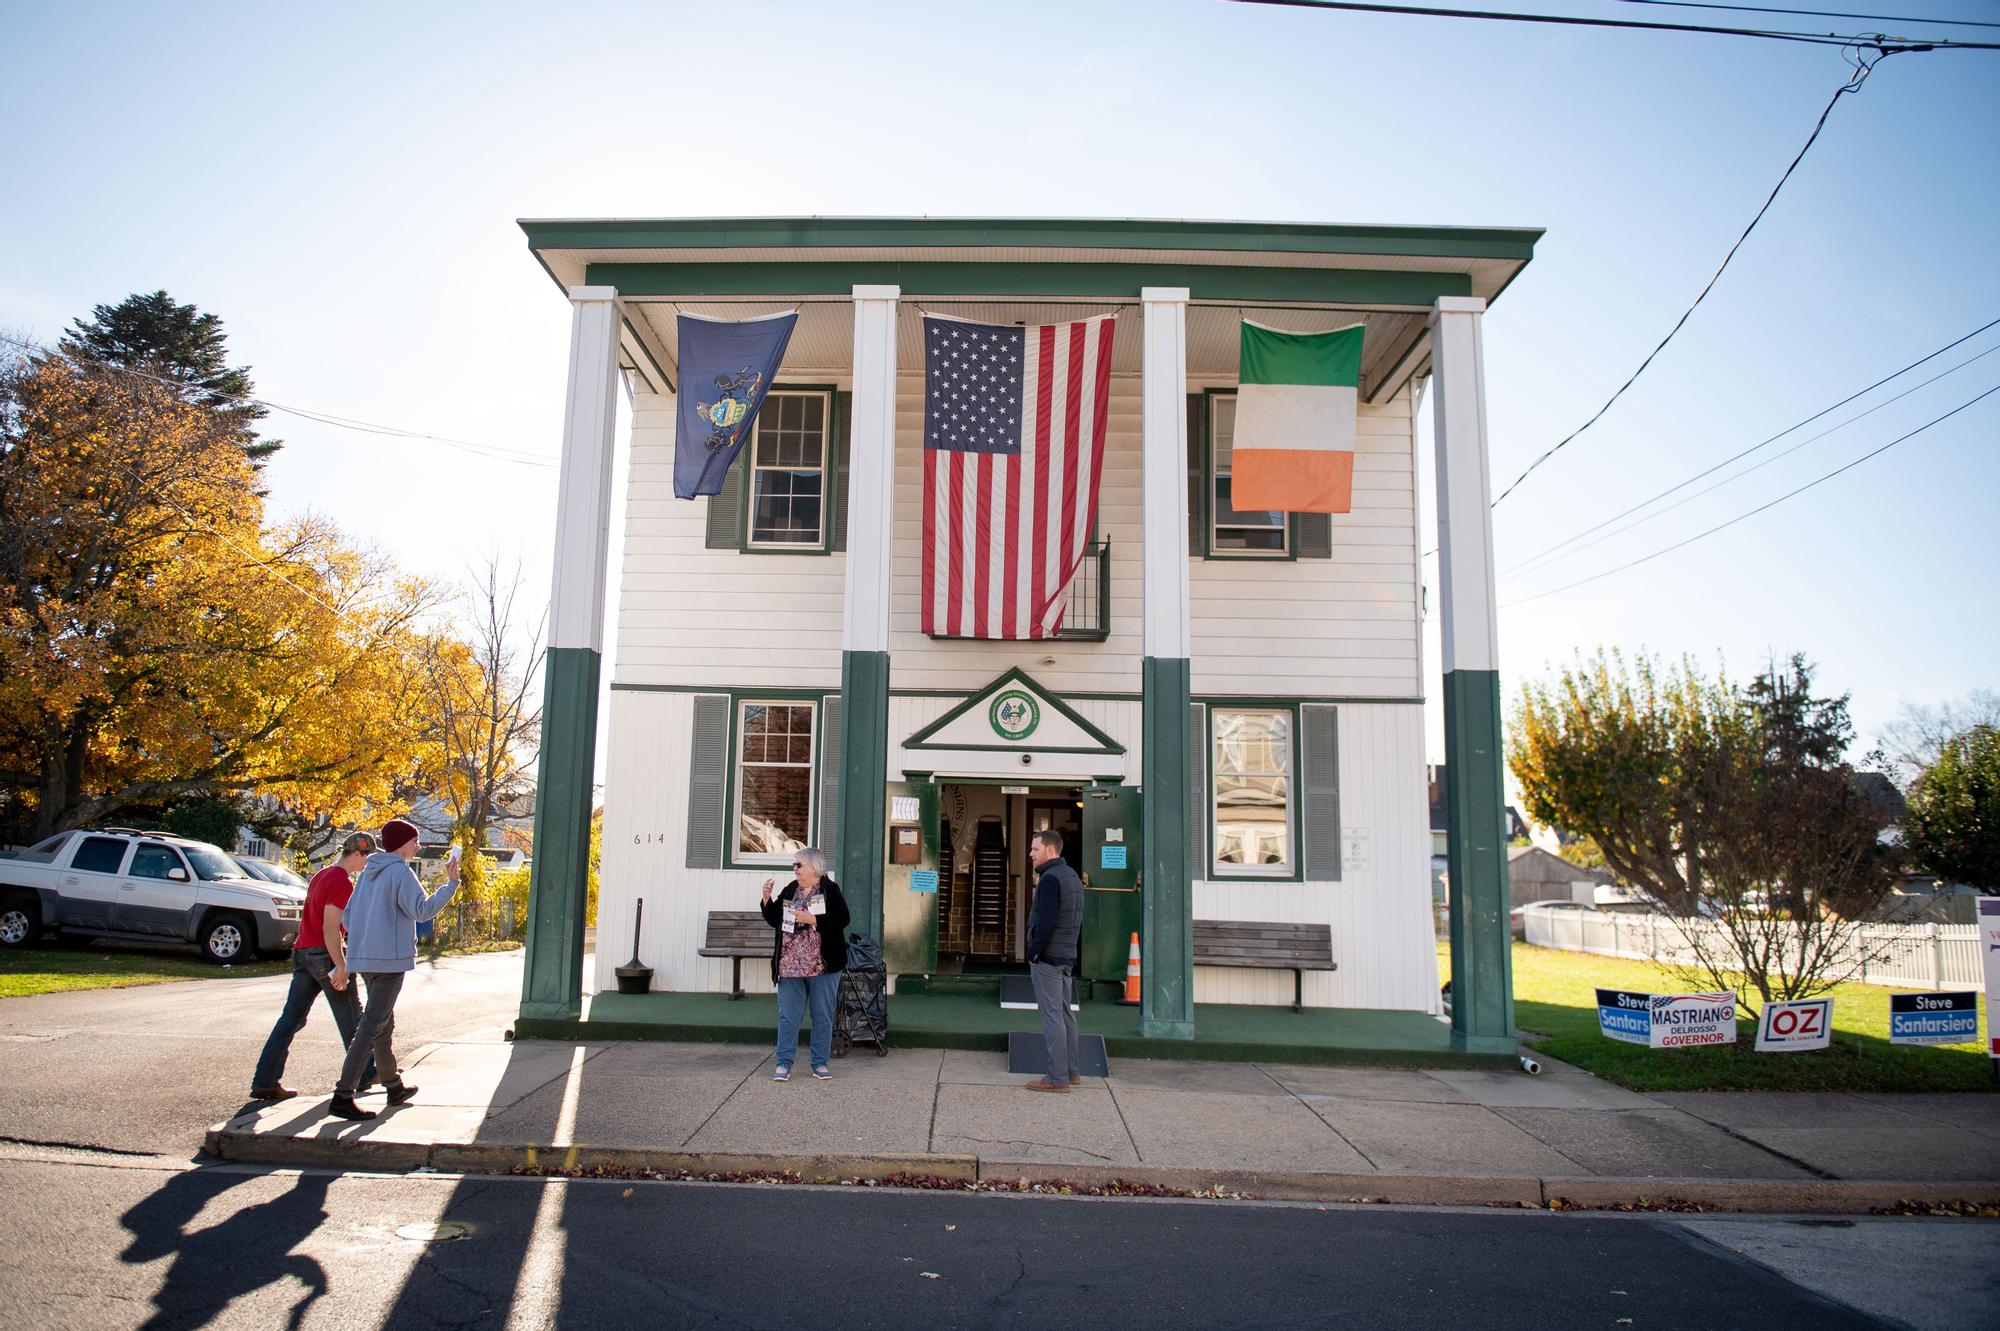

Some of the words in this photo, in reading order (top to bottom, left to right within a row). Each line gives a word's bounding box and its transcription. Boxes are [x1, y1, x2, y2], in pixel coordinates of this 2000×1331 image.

[634, 834, 664, 845] 614
[1617, 993, 1650, 1010] Steve
[1915, 996, 1953, 1010] Steve
[1601, 1009, 1649, 1032] Santars
[1773, 1008, 1819, 1035] OZ
[1894, 1014, 1975, 1033] Santarsiero
[1671, 1025, 1717, 1035] DELROSSO
[1663, 1033, 1724, 1046] GOVERNOR
